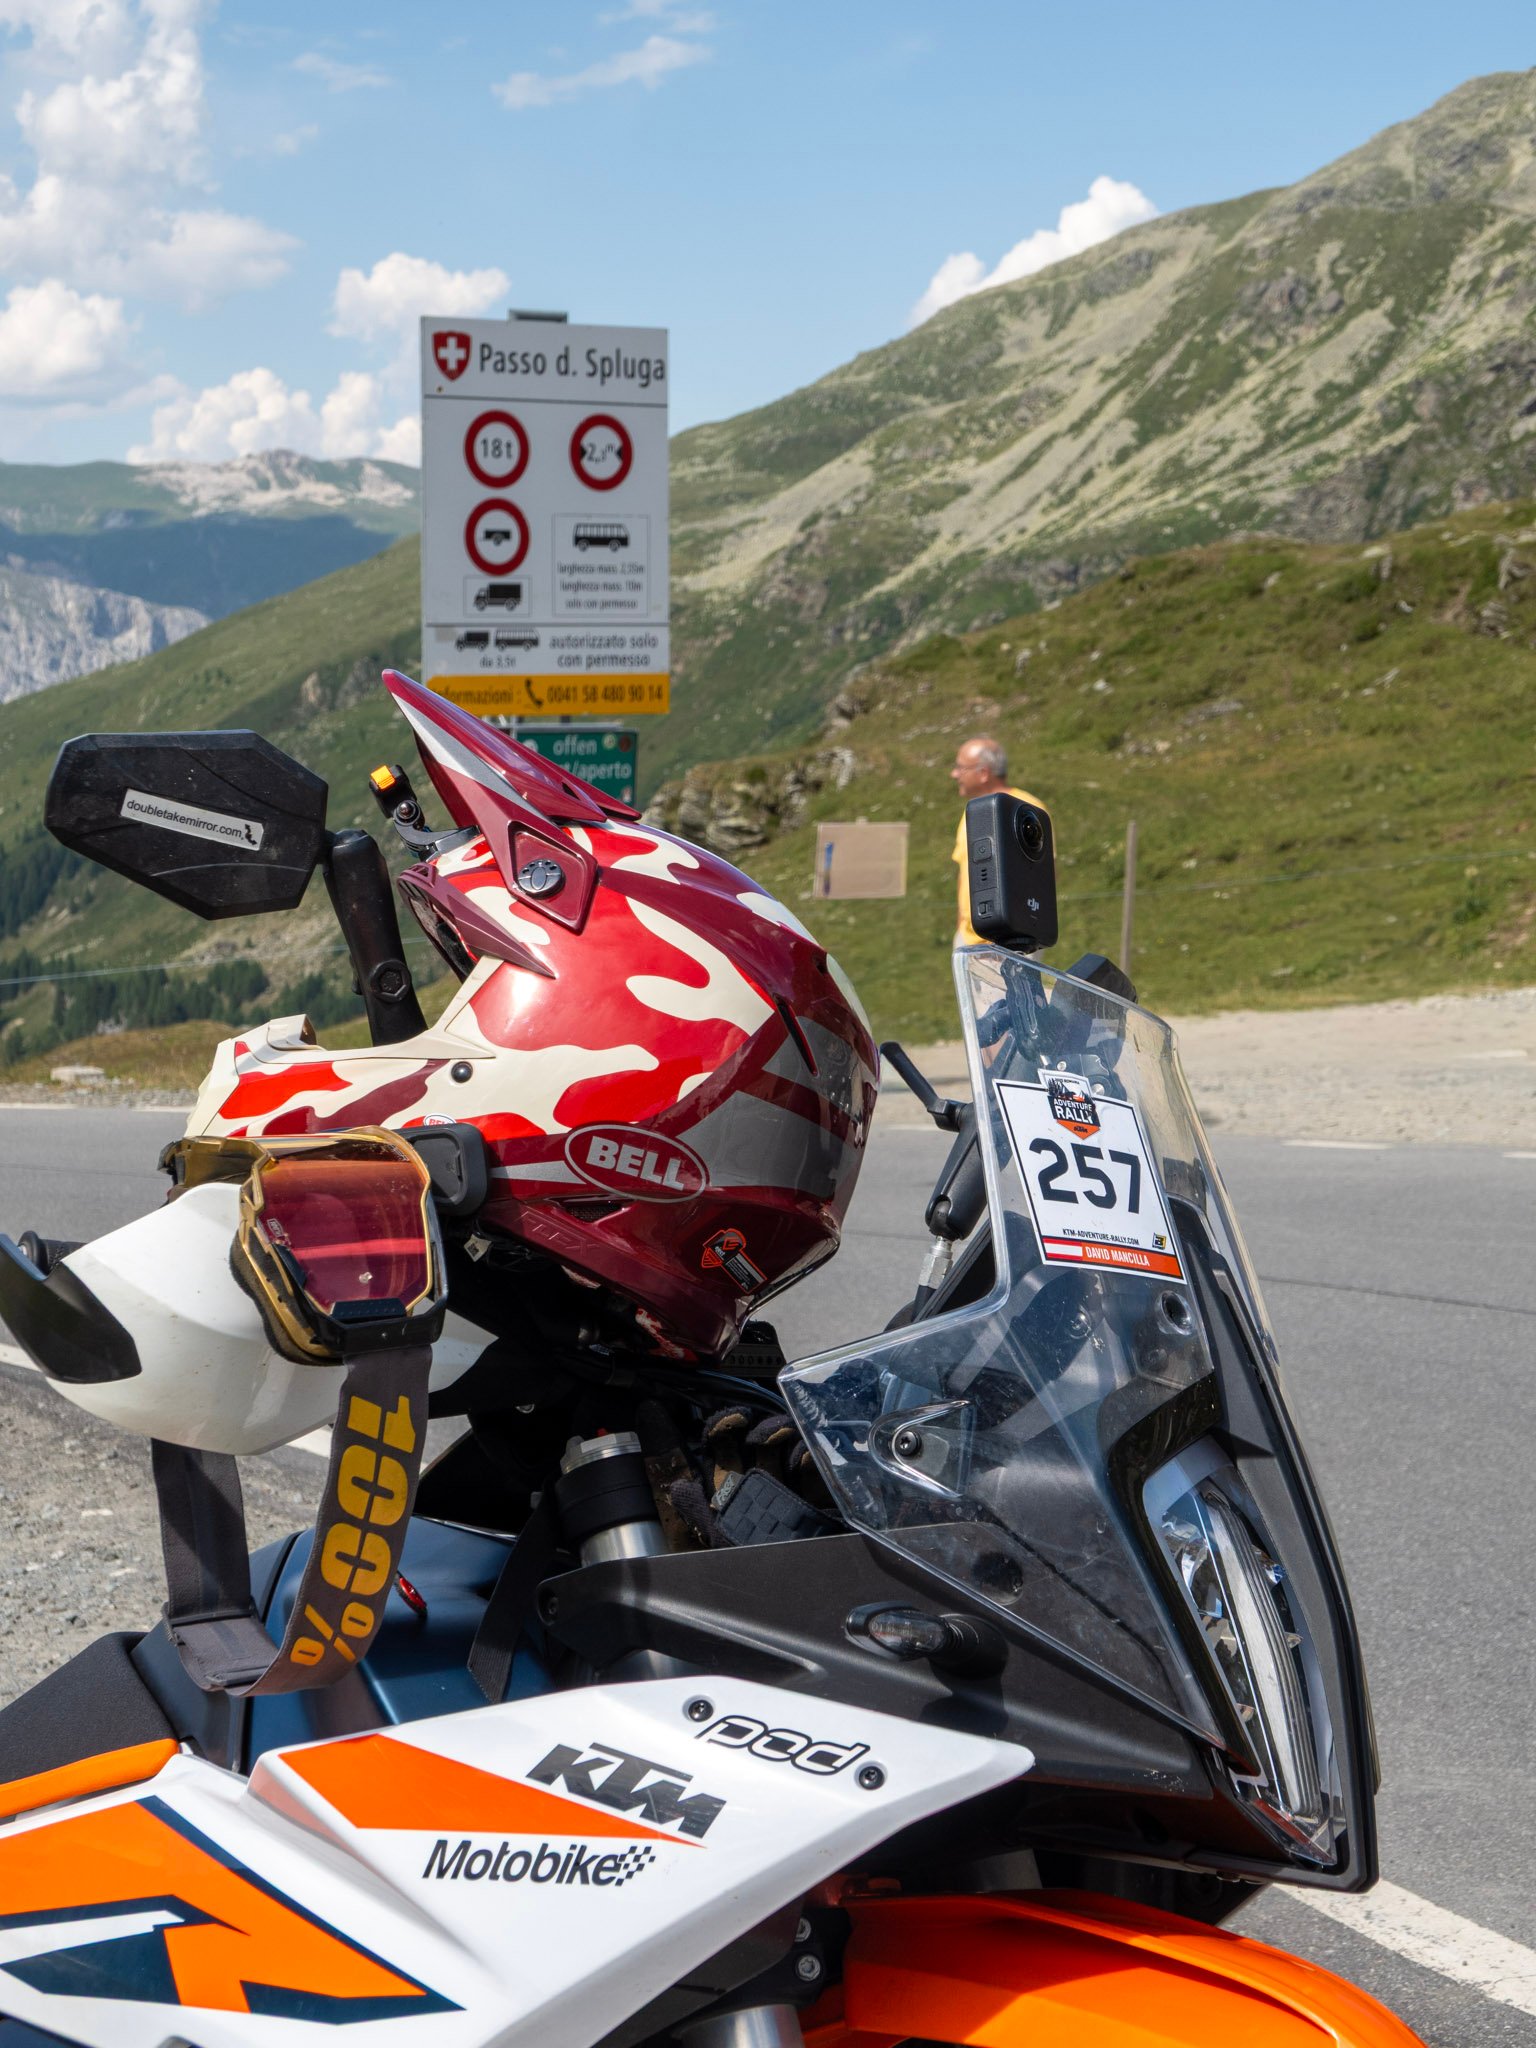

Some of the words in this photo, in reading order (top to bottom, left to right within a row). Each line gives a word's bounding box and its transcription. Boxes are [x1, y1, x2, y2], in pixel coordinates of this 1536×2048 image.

[479, 343, 546, 375] Passo
[556, 346, 577, 376] d.
[585, 348, 666, 388] Spluga
[600, 600, 637, 611] permesso
[549, 633, 626, 648] autorizzato
[630, 632, 659, 648] solo
[557, 655, 582, 668] con
[586, 655, 651, 670] permesso
[547, 685, 577, 703] 0041
[582, 685, 598, 703] 58
[602, 685, 624, 702] 480
[628, 685, 645, 702] 90
[648, 684, 663, 702] 14
[553, 734, 598, 755] offen
[126, 799, 243, 840] doubletakemirror.com
[1053, 1098, 1093, 1111] ADVENTURE
[1054, 1105, 1094, 1124] RALLY
[585, 1135, 685, 1191] BELL
[1028, 1137, 1141, 1215] 257
[1062, 1228, 1140, 1246] KTM-ADVENTURE-RALLY.COM
[1085, 1246, 1111, 1260] DAVID
[1111, 1248, 1151, 1267] MANCILLA
[290, 1395, 417, 1666] 100%
[524, 1742, 727, 1839] KTM
[422, 1839, 622, 1886] Motobike
